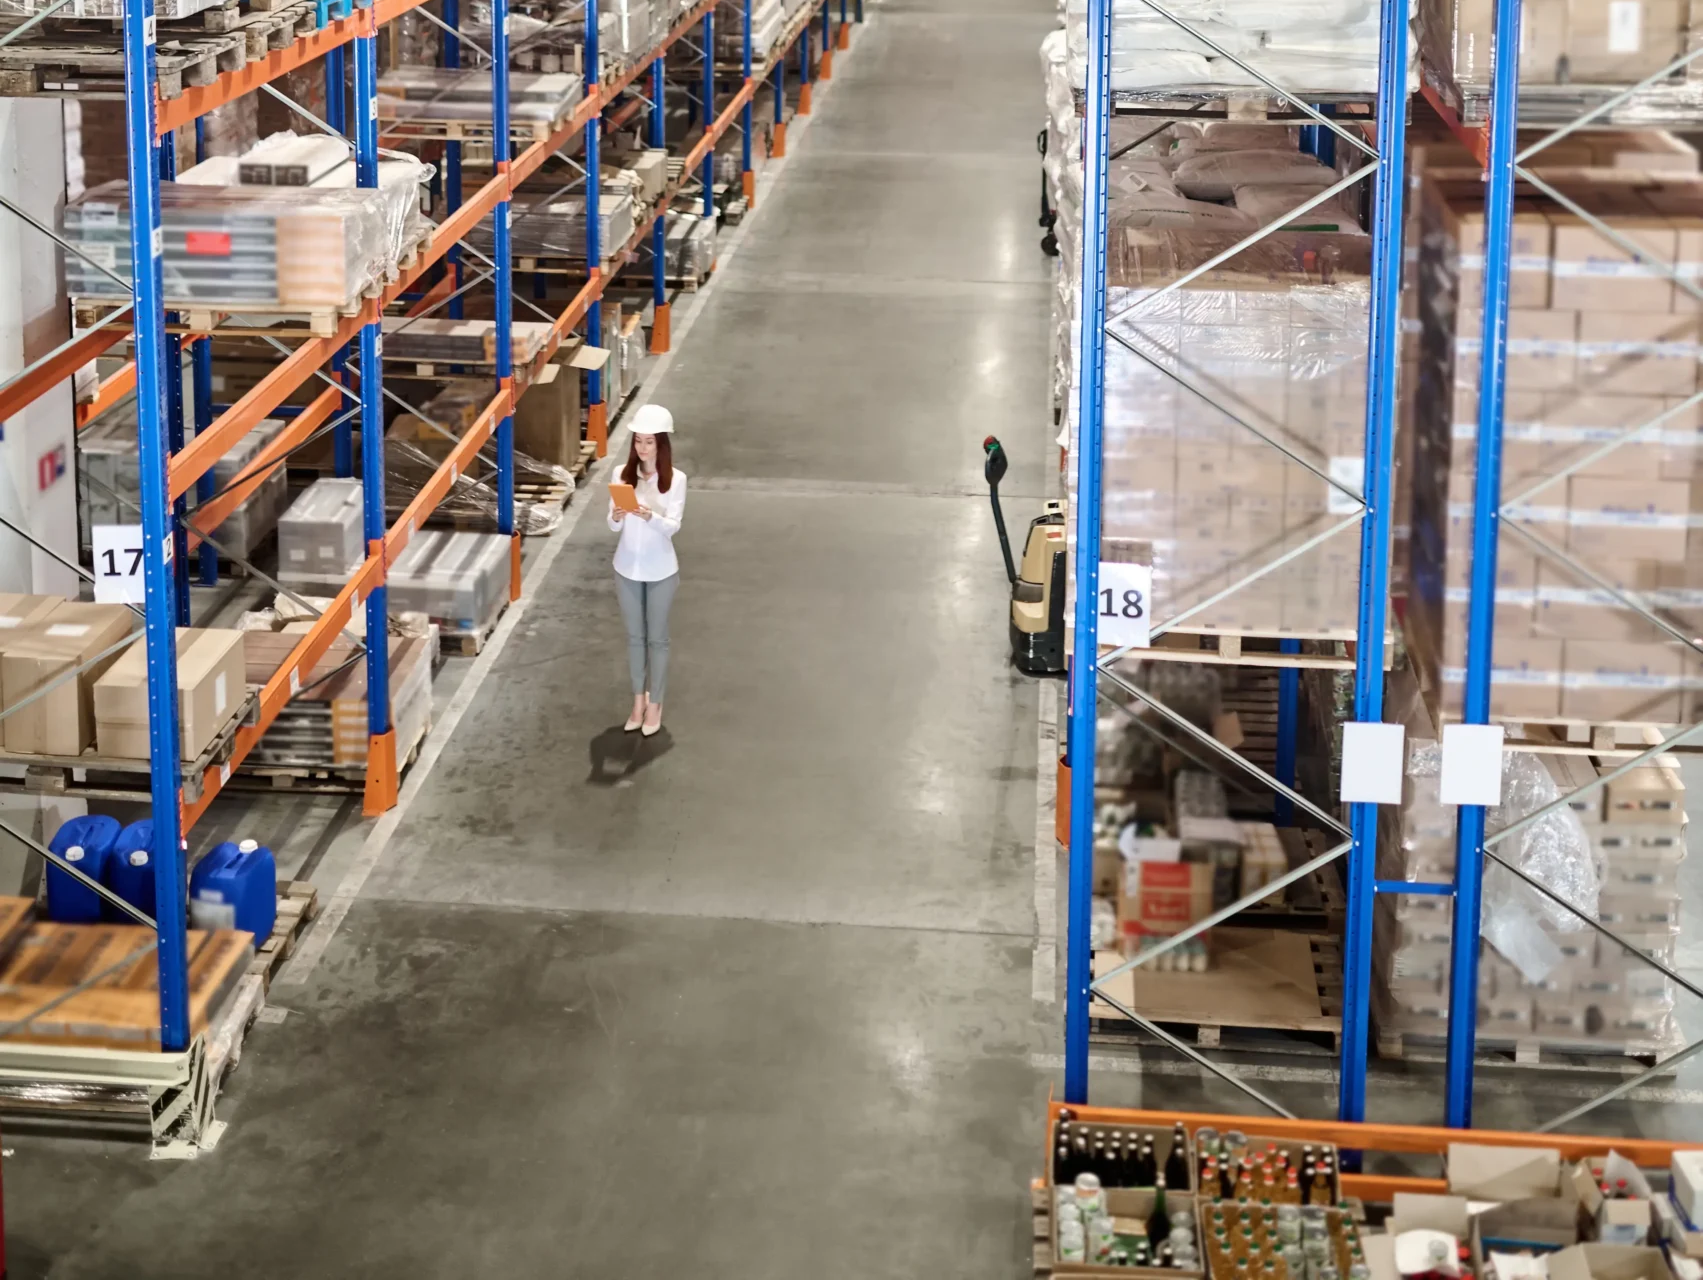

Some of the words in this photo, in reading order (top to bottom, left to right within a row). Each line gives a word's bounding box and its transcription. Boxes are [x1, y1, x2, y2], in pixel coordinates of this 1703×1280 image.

[147, 20, 154, 41] 4
[166, 537, 172, 558] 2
[102, 549, 144, 576] 17
[1099, 588, 1143, 619] 18
